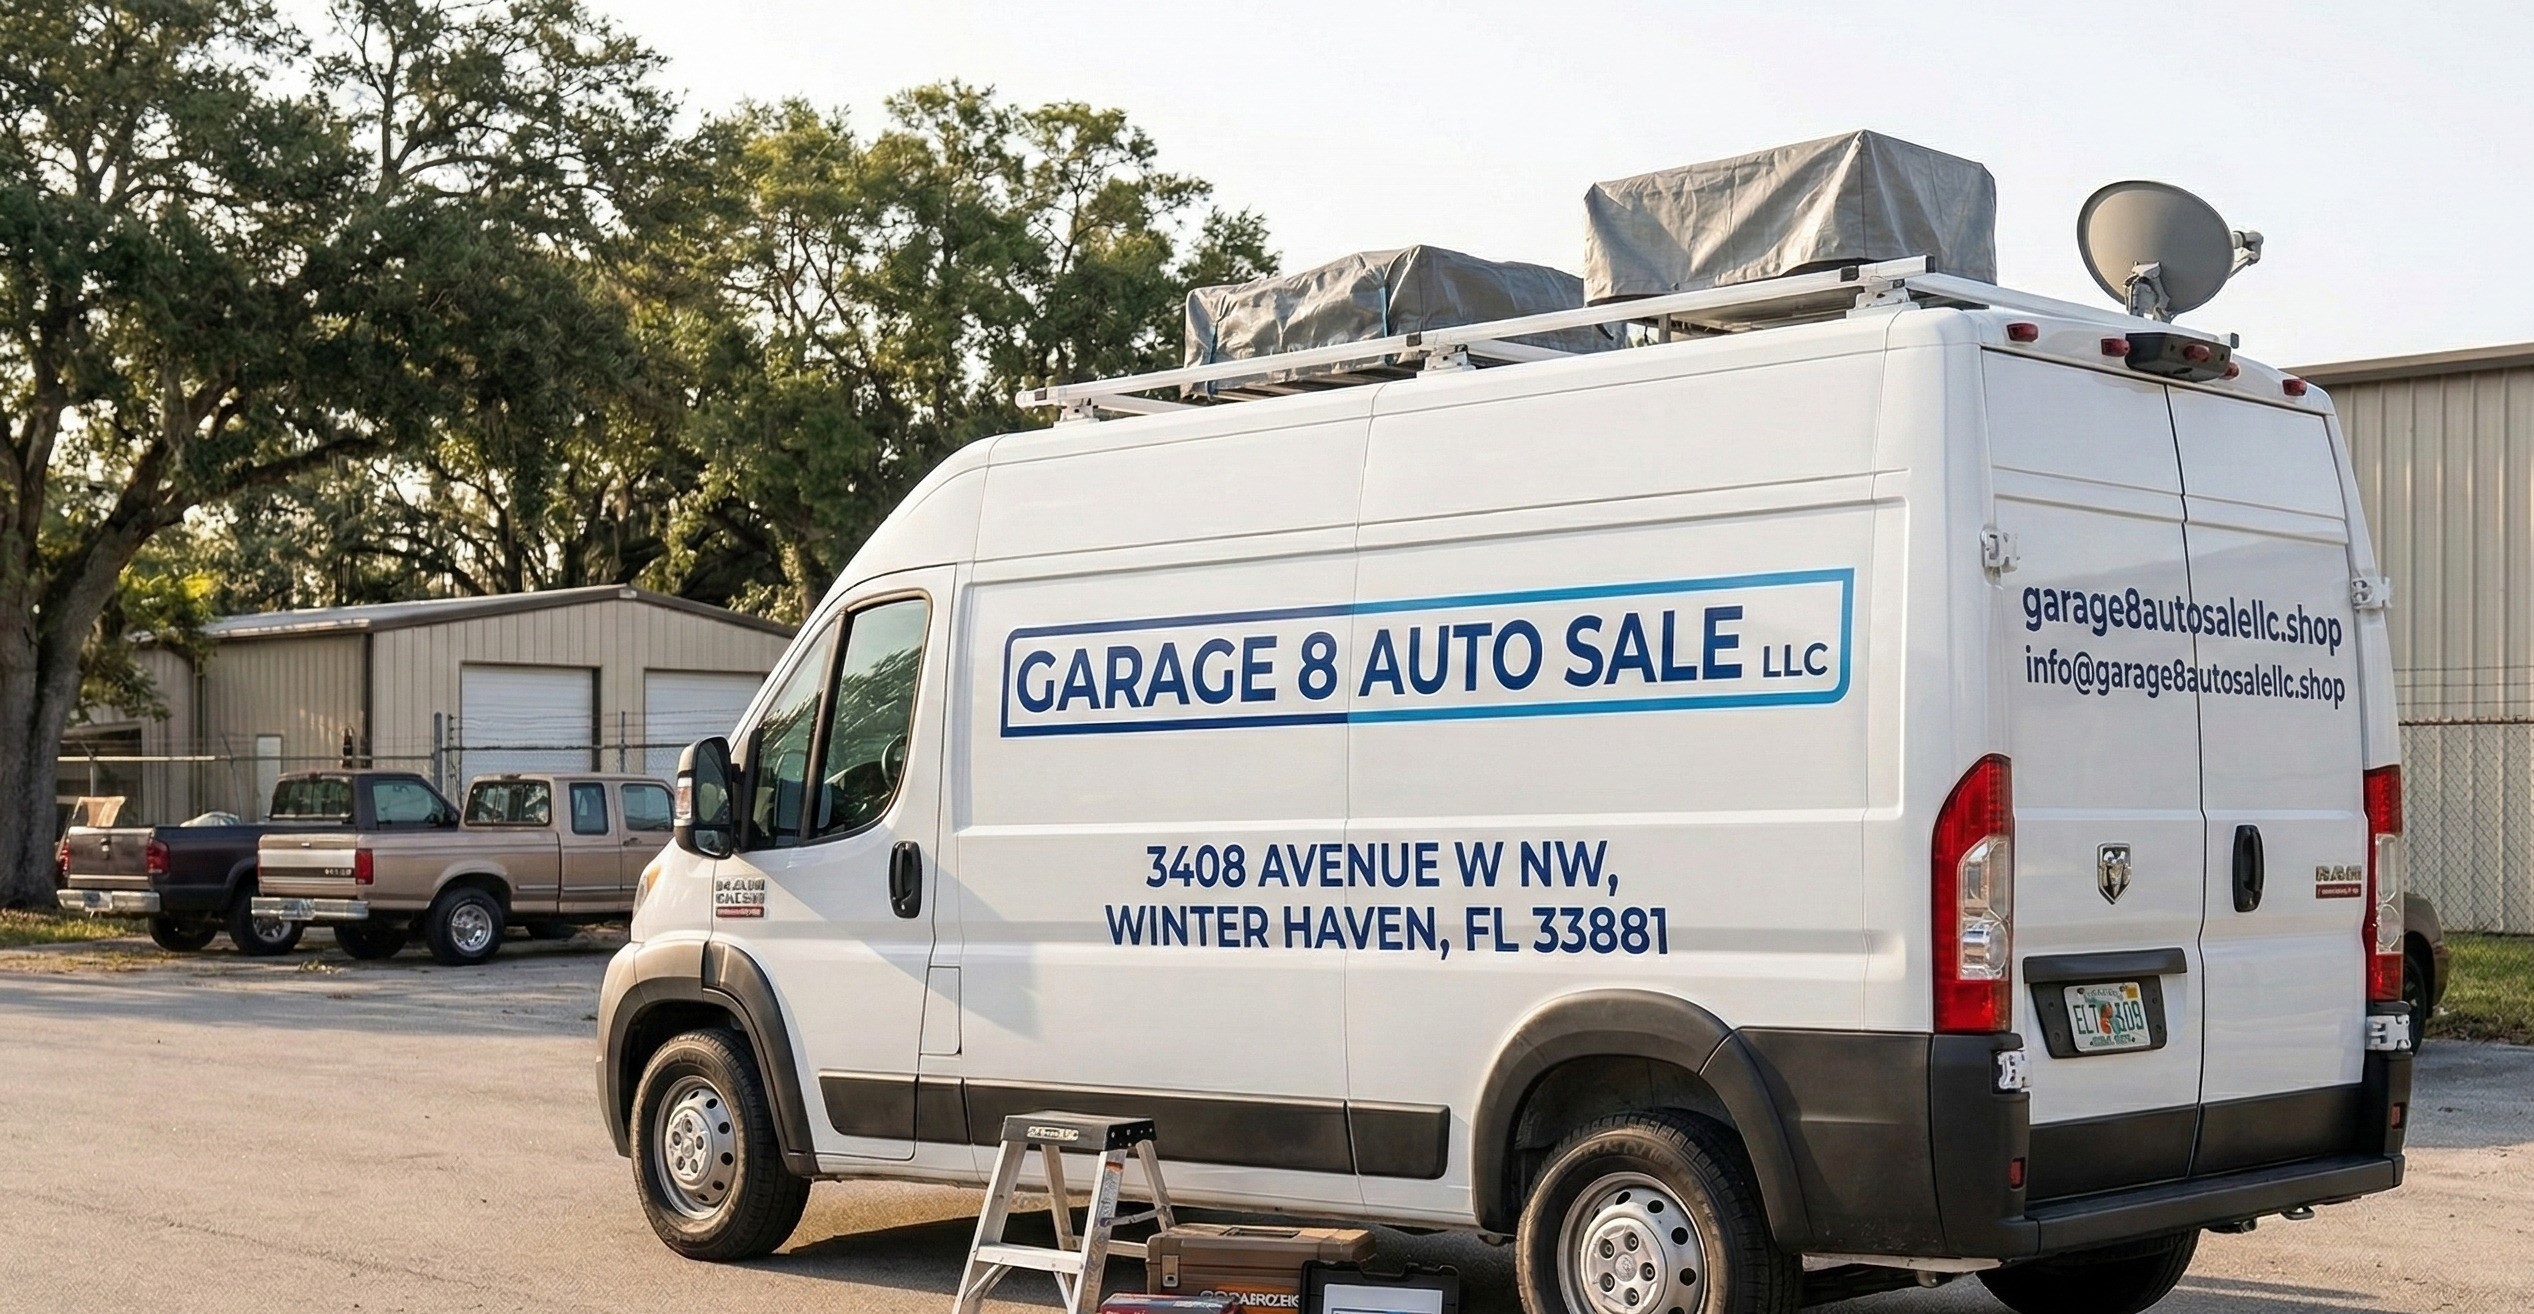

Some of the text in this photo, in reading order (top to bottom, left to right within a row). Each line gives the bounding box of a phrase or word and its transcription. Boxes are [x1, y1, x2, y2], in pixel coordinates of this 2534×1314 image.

[2022, 586, 2343, 657] garage8autosalellc.shop
[1016, 605, 1828, 713] GARAGE 8 AUTO SALE LLC
[2025, 644, 2346, 711] info@garage8autosalellc.shop
[1145, 840, 1619, 897] 3408 AVENUE W NW,
[1104, 904, 1668, 961] WINTER HAVEN, FL 33881
